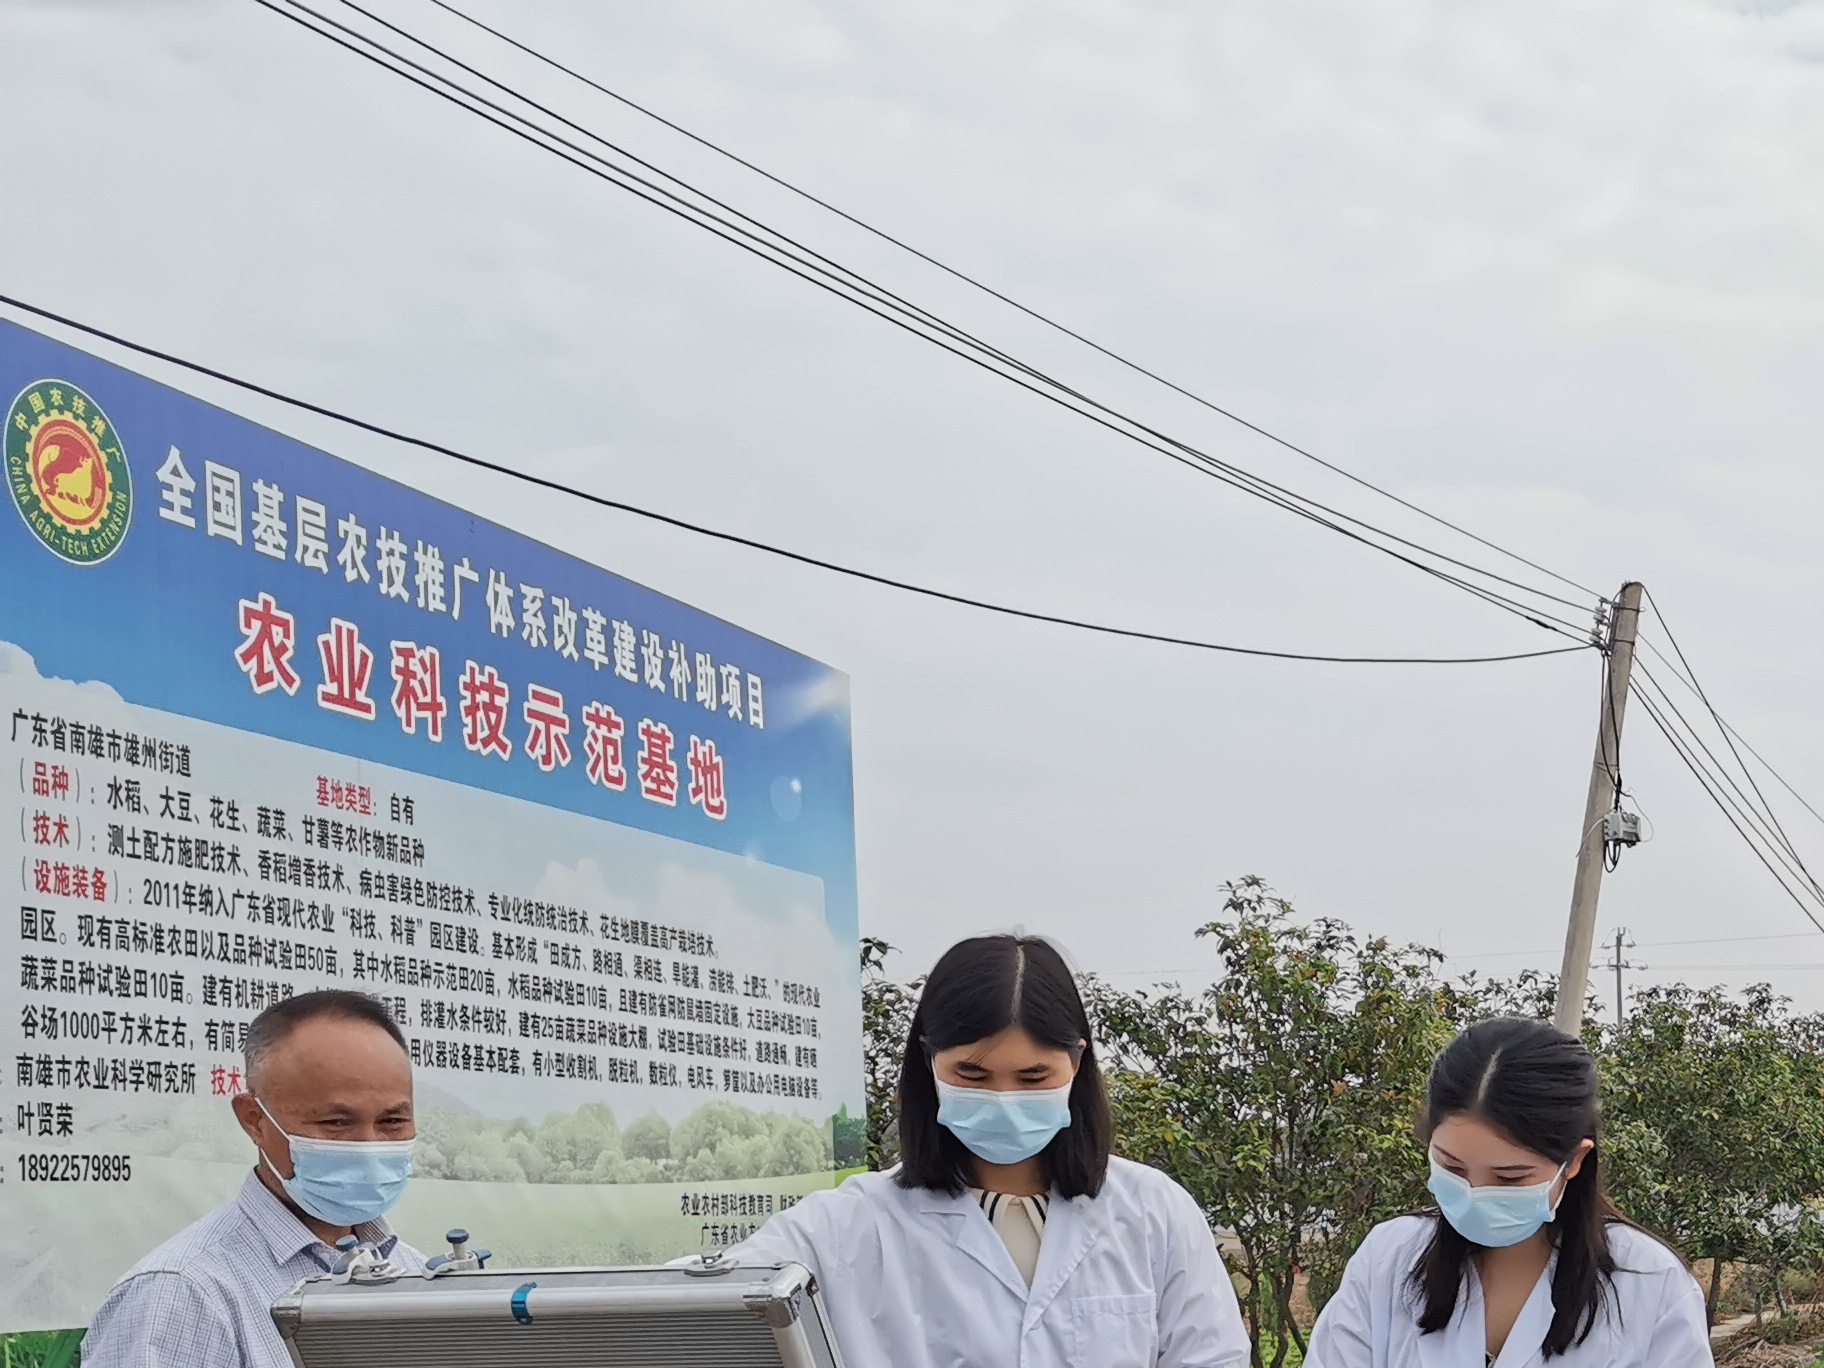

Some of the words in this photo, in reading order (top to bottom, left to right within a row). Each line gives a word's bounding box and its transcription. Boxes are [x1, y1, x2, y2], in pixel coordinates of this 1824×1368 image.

[14, 386, 122, 463] 中国农技推广
[10, 456, 31, 505] CHINA
[29, 510, 90, 556] AGRI-TECH
[91, 491, 127, 554] EXTENSION
[156, 444, 765, 729] 全国基层农技推广体系改革建设补助项目
[234, 591, 727, 820] 农业科技示范基地
[11, 708, 191, 777] 广东省南雄市雄州街道
[16, 1052, 196, 1095] 南雄市农业科学研究所
[17, 1101, 74, 1138] 叶贤荣
[18, 1153, 131, 1183] 18922579895
